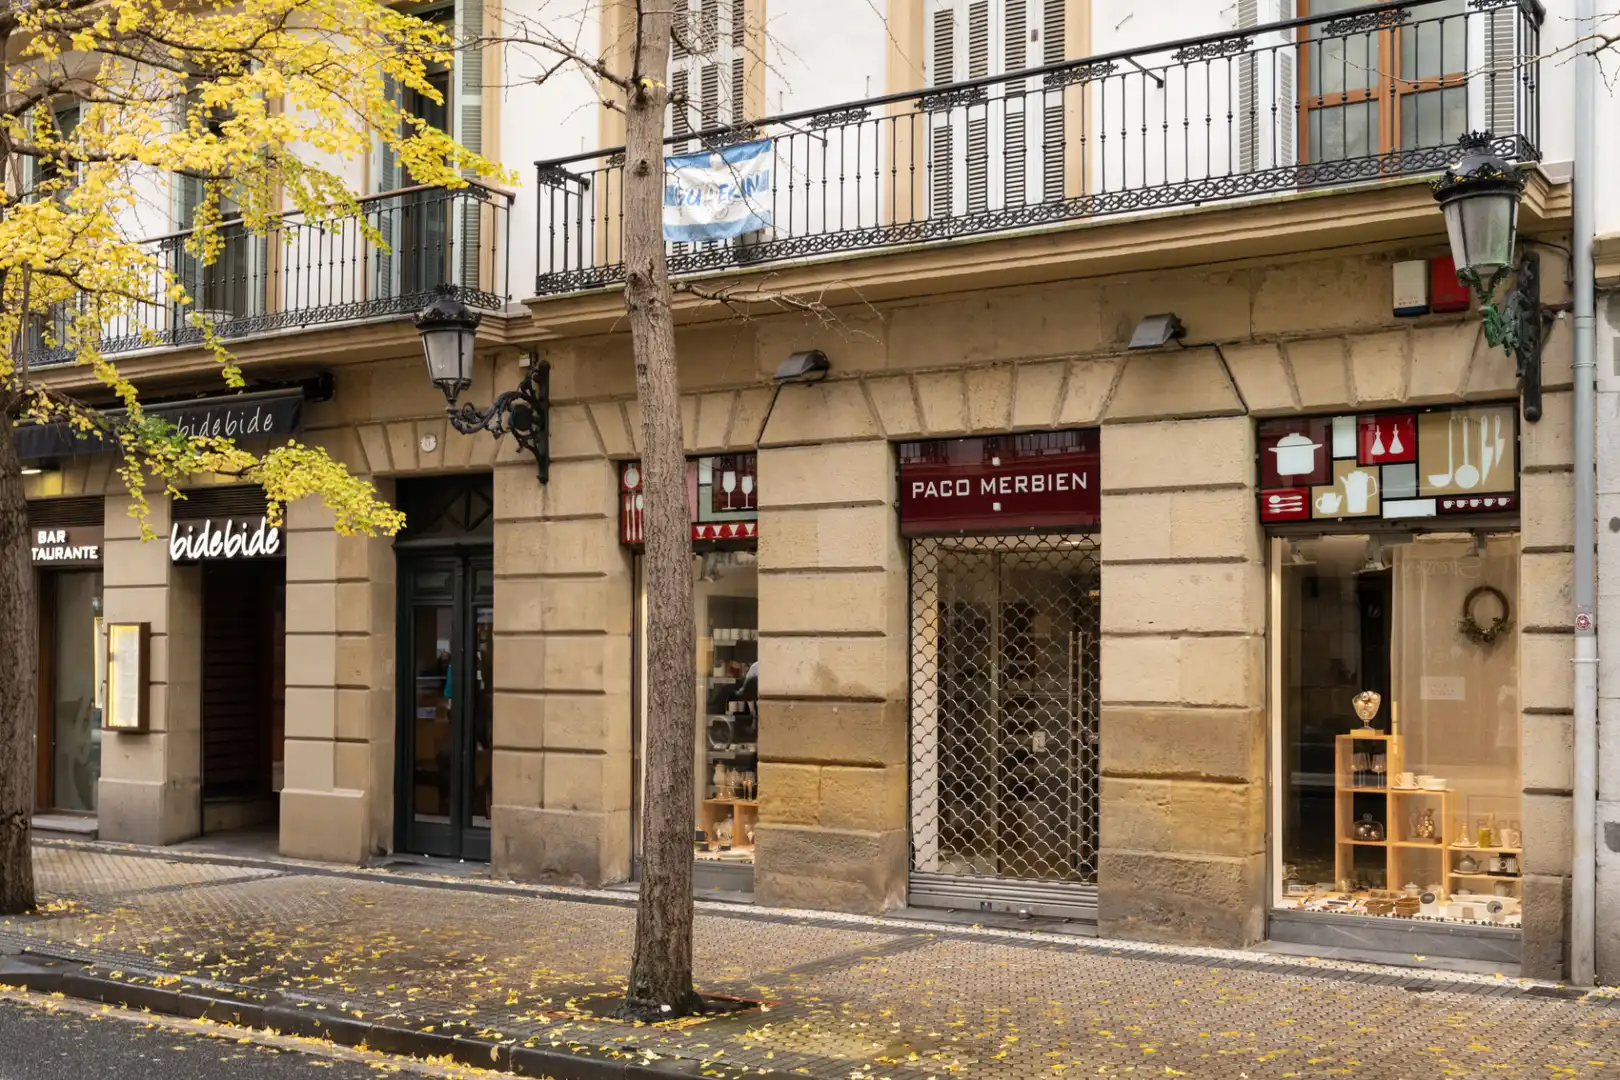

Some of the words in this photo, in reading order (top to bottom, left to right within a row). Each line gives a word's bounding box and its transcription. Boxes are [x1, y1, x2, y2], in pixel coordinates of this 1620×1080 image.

[176, 407, 273, 437] bidebide
[912, 478, 970, 499] PACO
[980, 471, 1088, 495] MERBIEN
[37, 529, 66, 545] BAR
[170, 516, 280, 561] bidebide
[31, 545, 99, 561] TAURANTE
